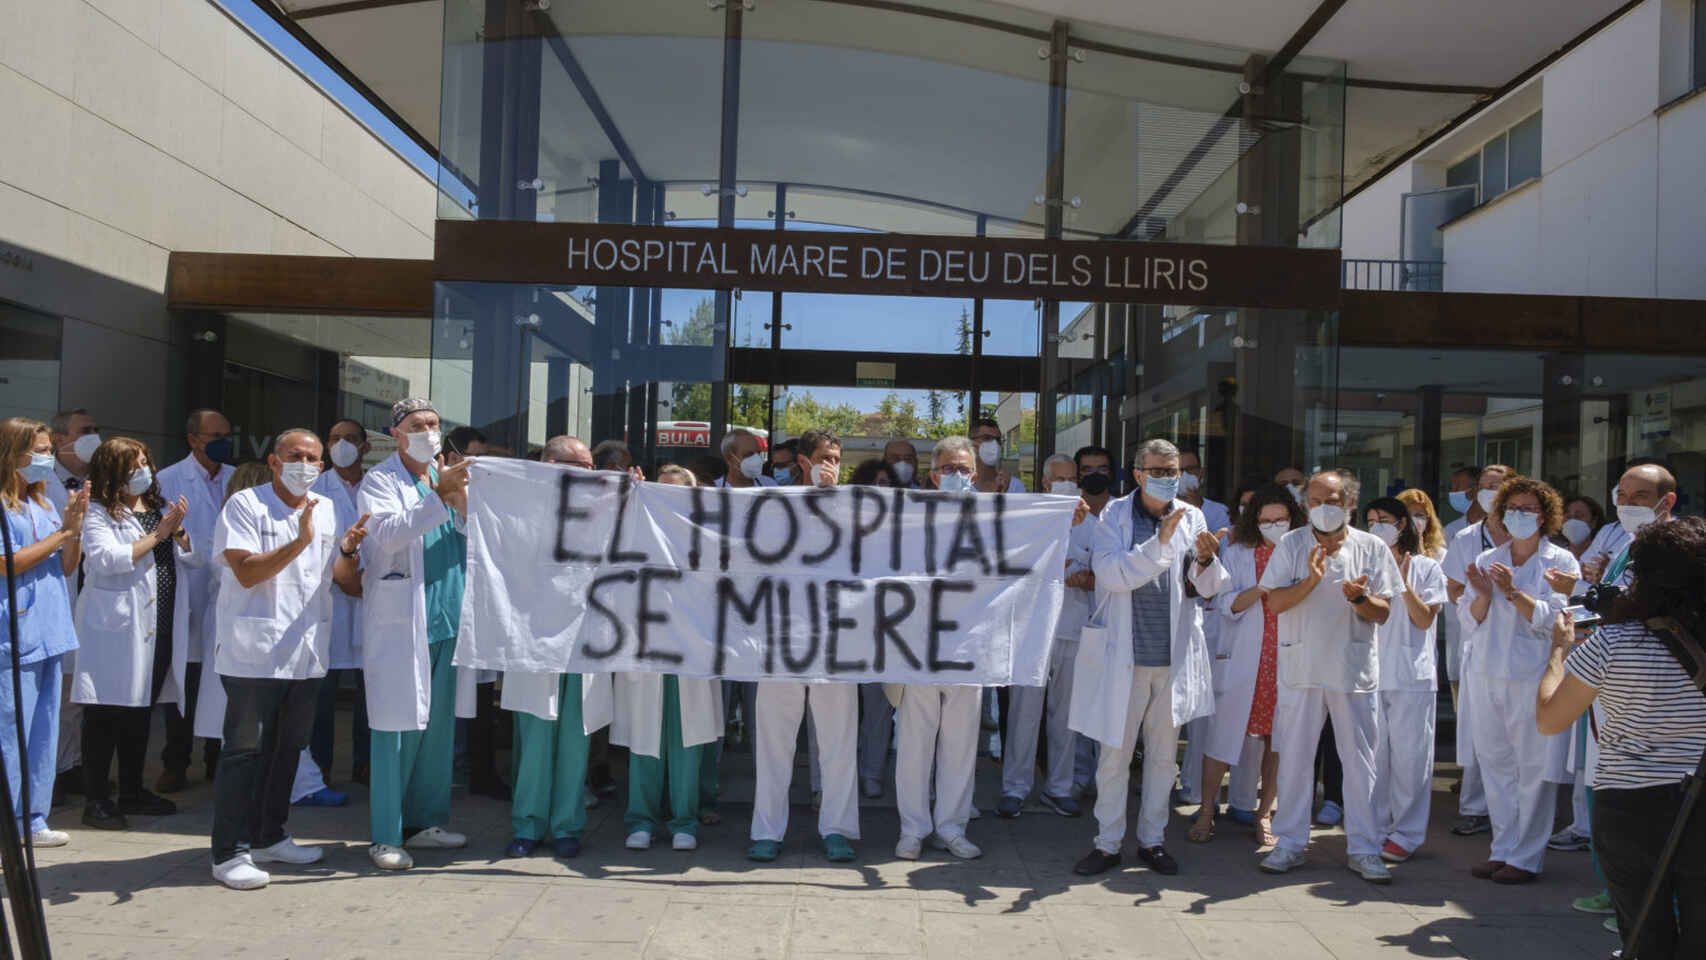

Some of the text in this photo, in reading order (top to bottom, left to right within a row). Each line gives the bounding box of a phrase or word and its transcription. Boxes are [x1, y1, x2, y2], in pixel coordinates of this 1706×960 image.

[568, 238, 1208, 291] HOSPITAL MARE DE DEU DELS LLIRIS
[554, 473, 1032, 577] EL HOSPITAL
[582, 567, 975, 675] SE MUERE
